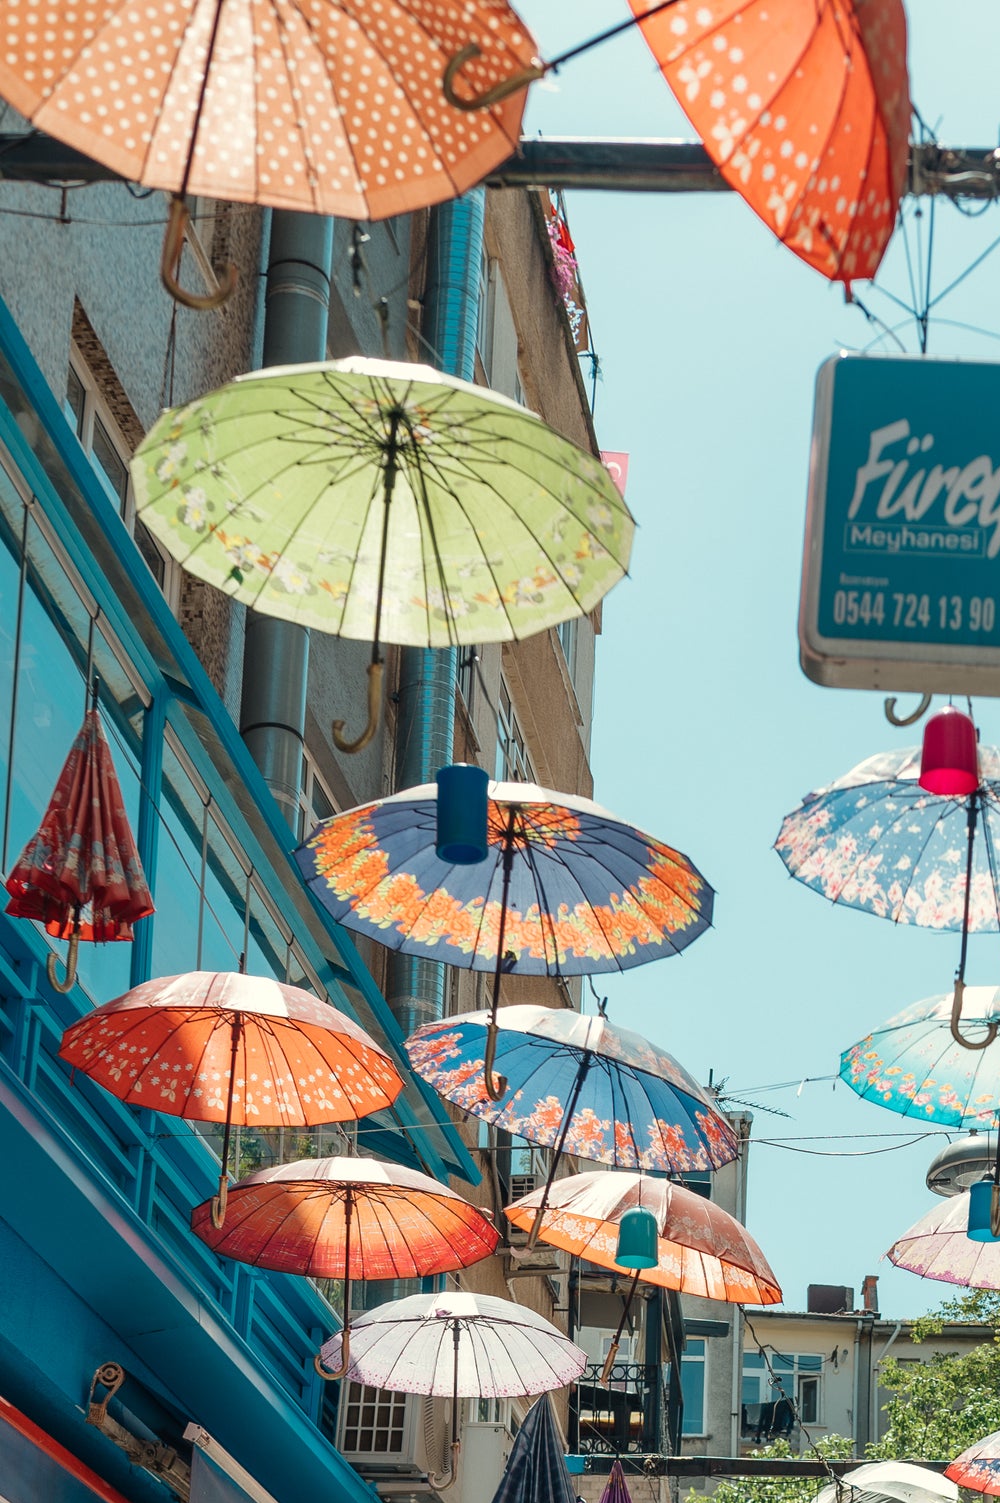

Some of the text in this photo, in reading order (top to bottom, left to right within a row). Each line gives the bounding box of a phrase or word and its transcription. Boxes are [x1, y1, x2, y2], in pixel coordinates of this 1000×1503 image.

[850, 525, 980, 552] Meyhanesi
[833, 590, 995, 632] 0544 724 13 90
